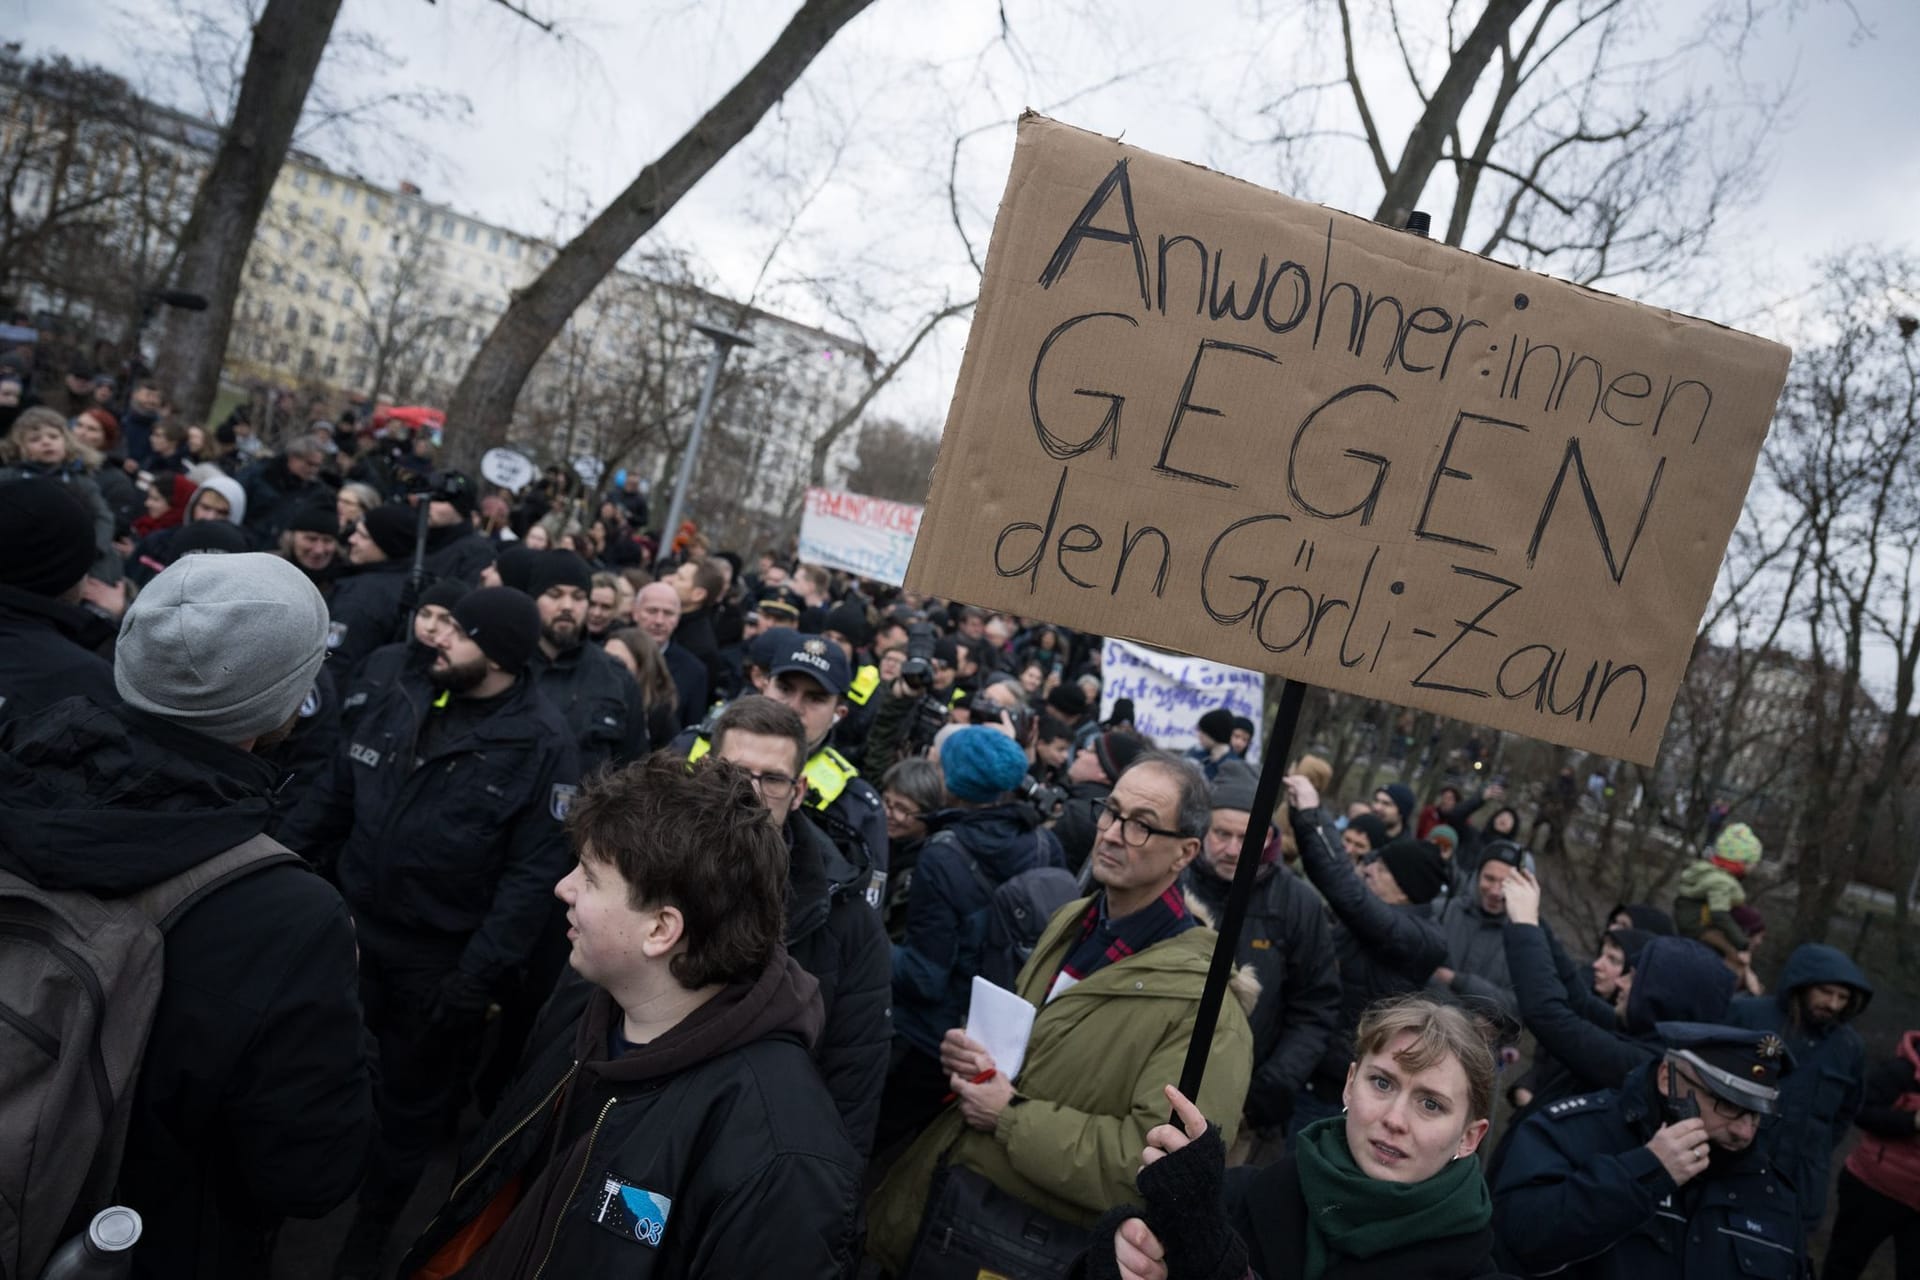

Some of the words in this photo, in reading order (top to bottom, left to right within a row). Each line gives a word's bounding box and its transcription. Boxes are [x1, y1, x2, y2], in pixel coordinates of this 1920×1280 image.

[1038, 157, 1713, 445] Anwohner:innen
[1029, 311, 1667, 587] GEGEN
[791, 651, 831, 672] POLIZEI
[994, 465, 1171, 598] den
[1200, 513, 1648, 736] Görli-Zaun
